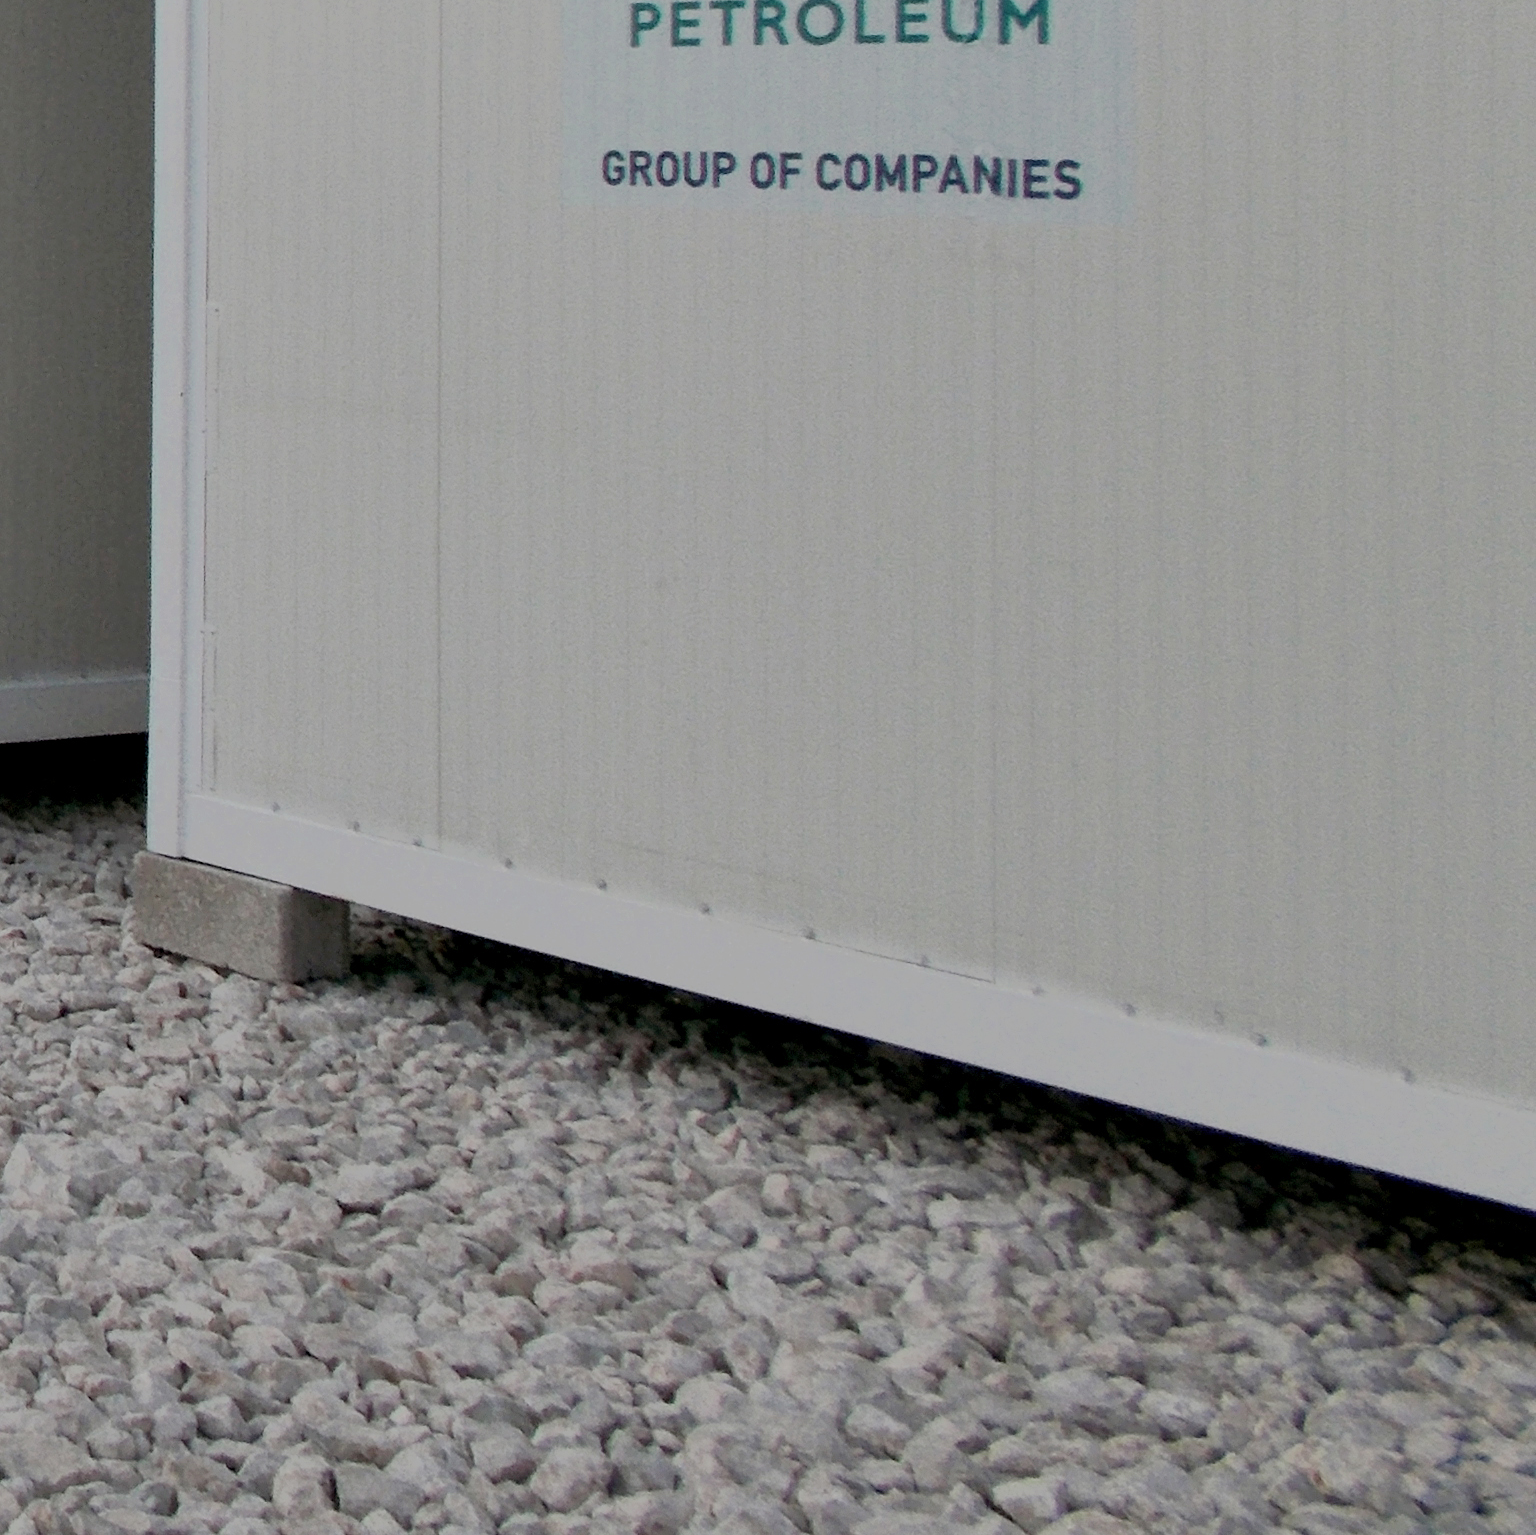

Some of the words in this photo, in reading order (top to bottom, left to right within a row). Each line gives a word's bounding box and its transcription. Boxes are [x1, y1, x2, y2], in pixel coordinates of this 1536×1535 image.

[602, 149, 737, 188] GROUP
[749, 151, 804, 191] OF
[815, 152, 1084, 200] COMPANIES
